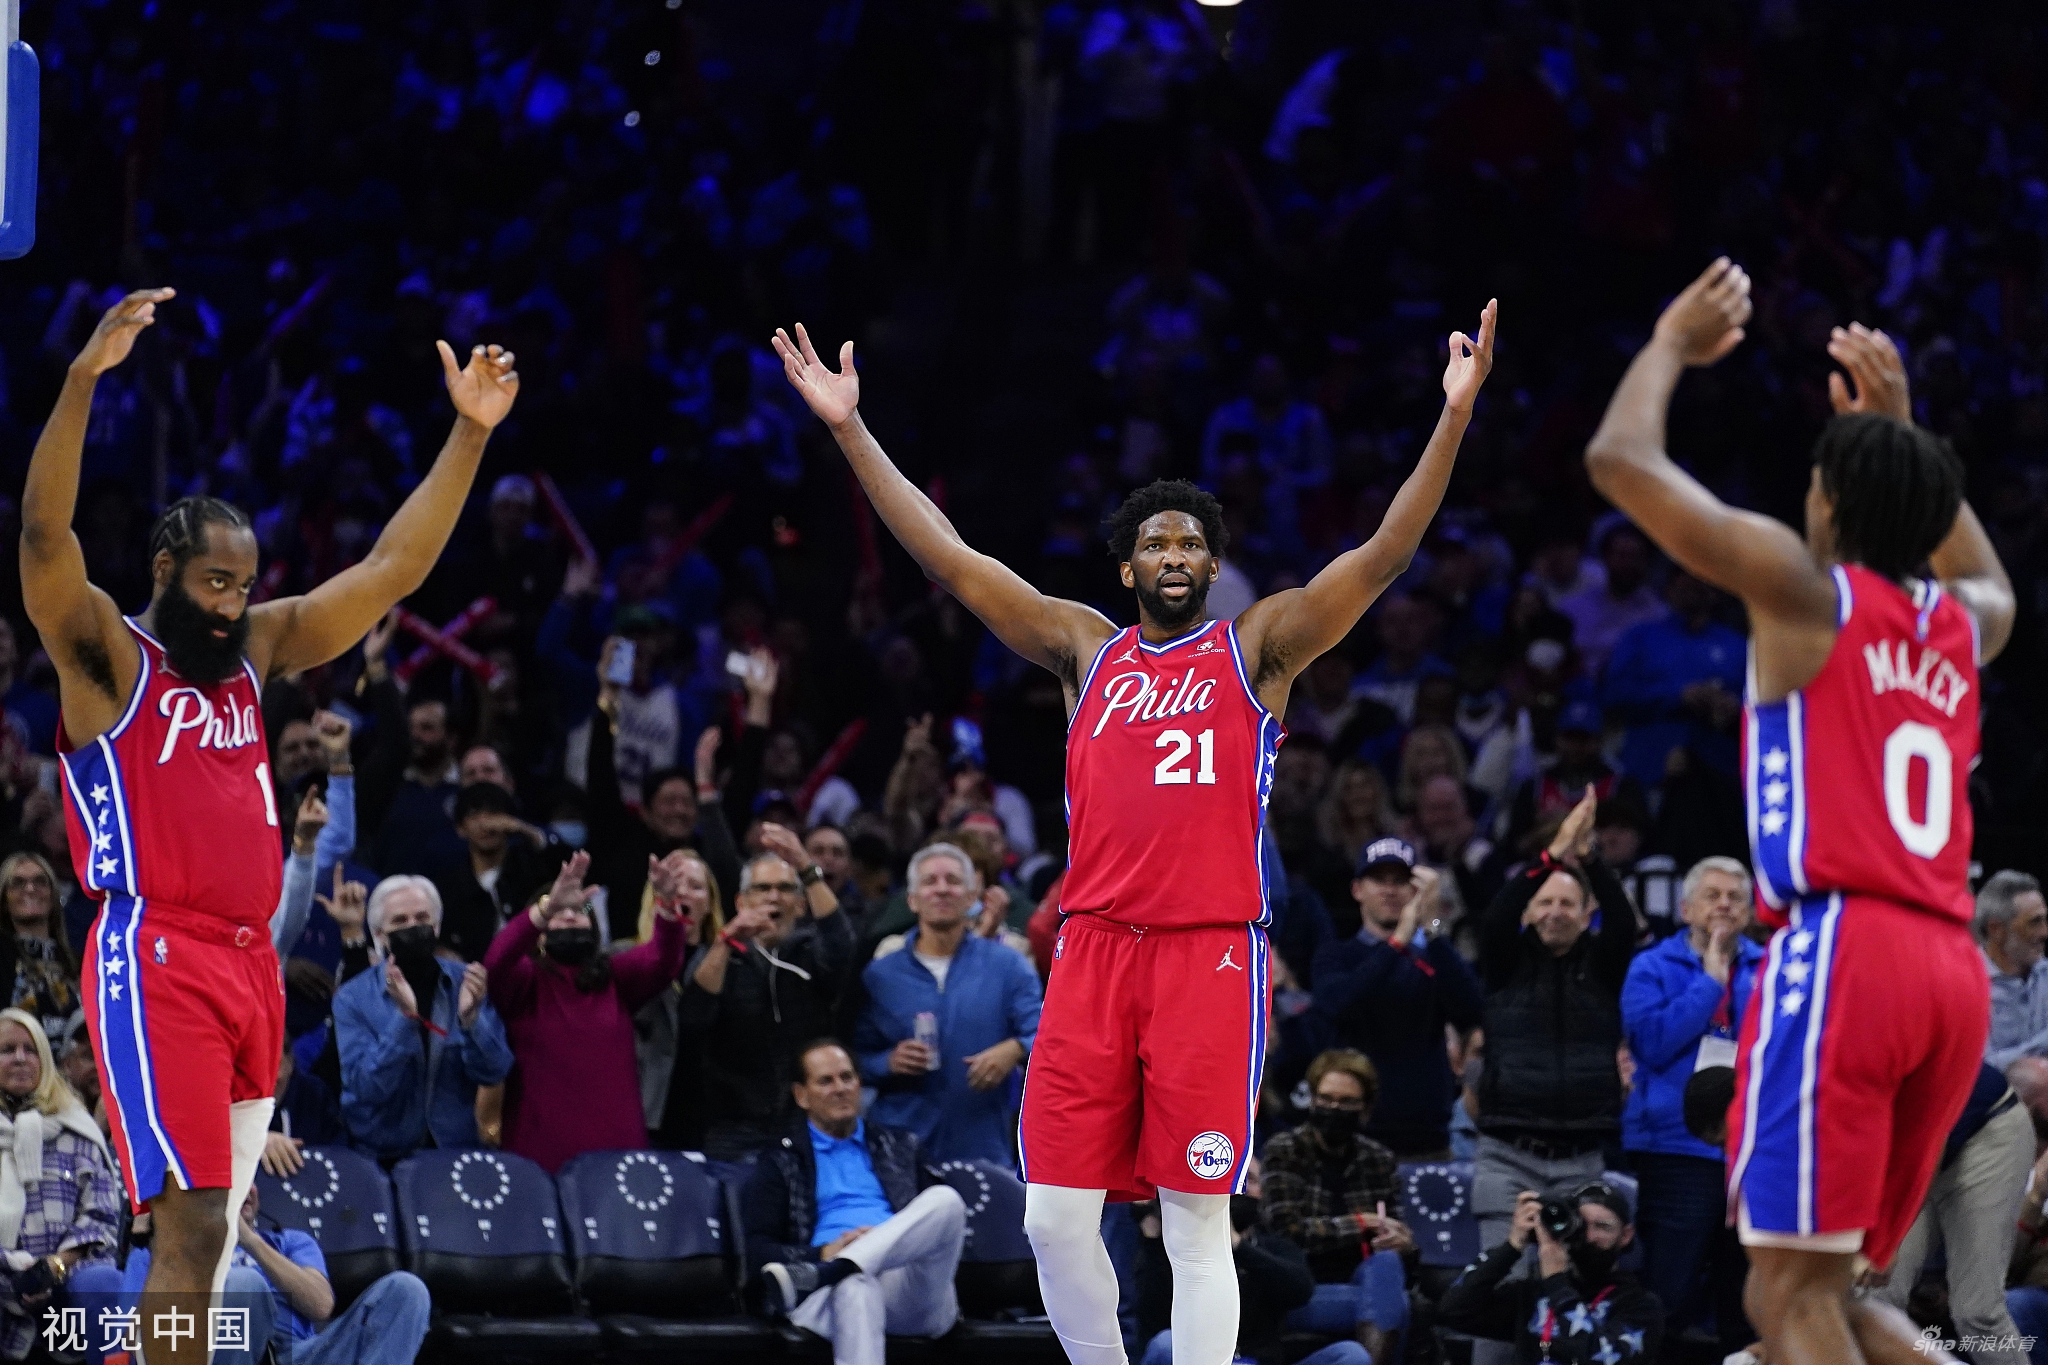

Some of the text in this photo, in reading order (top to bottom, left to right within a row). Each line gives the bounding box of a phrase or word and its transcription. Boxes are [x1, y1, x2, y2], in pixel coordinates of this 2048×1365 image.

[1187, 648, 1226, 658] cryptocom
[157, 687, 259, 766] Phila
[1091, 667, 1217, 739] Phila
[1154, 728, 1217, 785] 21
[254, 762, 279, 827] 1
[1884, 719, 1953, 860] 0
[1192, 1149, 1229, 1167] 76ers
